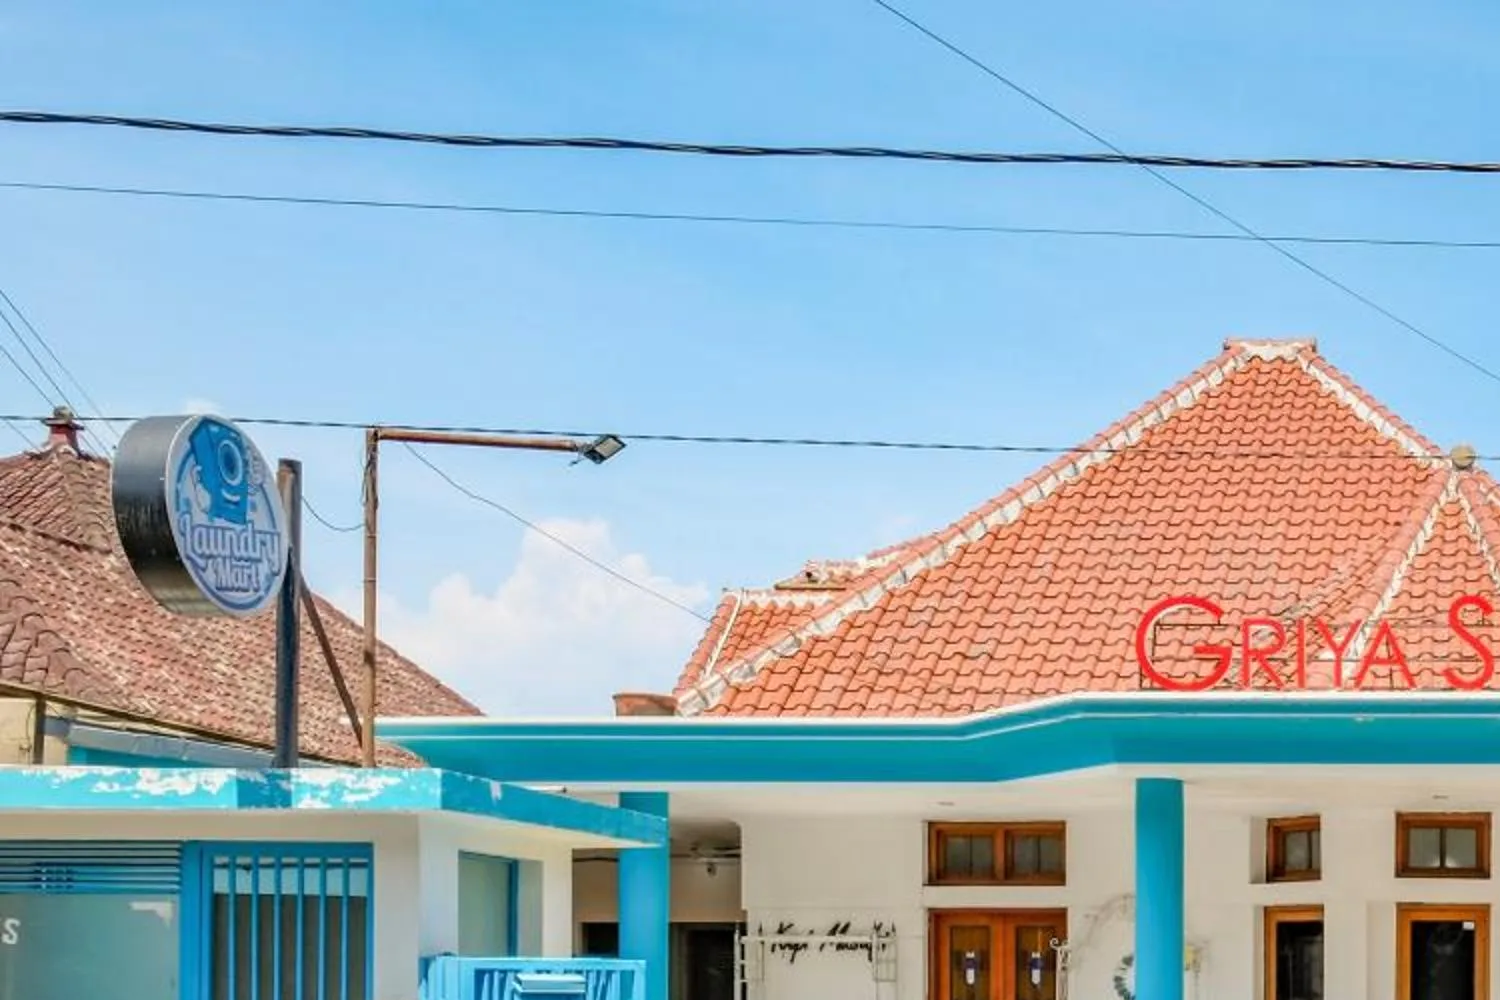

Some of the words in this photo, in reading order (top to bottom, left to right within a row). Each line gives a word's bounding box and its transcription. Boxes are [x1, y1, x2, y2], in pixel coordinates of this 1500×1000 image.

[178, 511, 281, 577] Laundry
[214, 558, 261, 592] Mart
[1135, 595, 1416, 692] GRIYA
